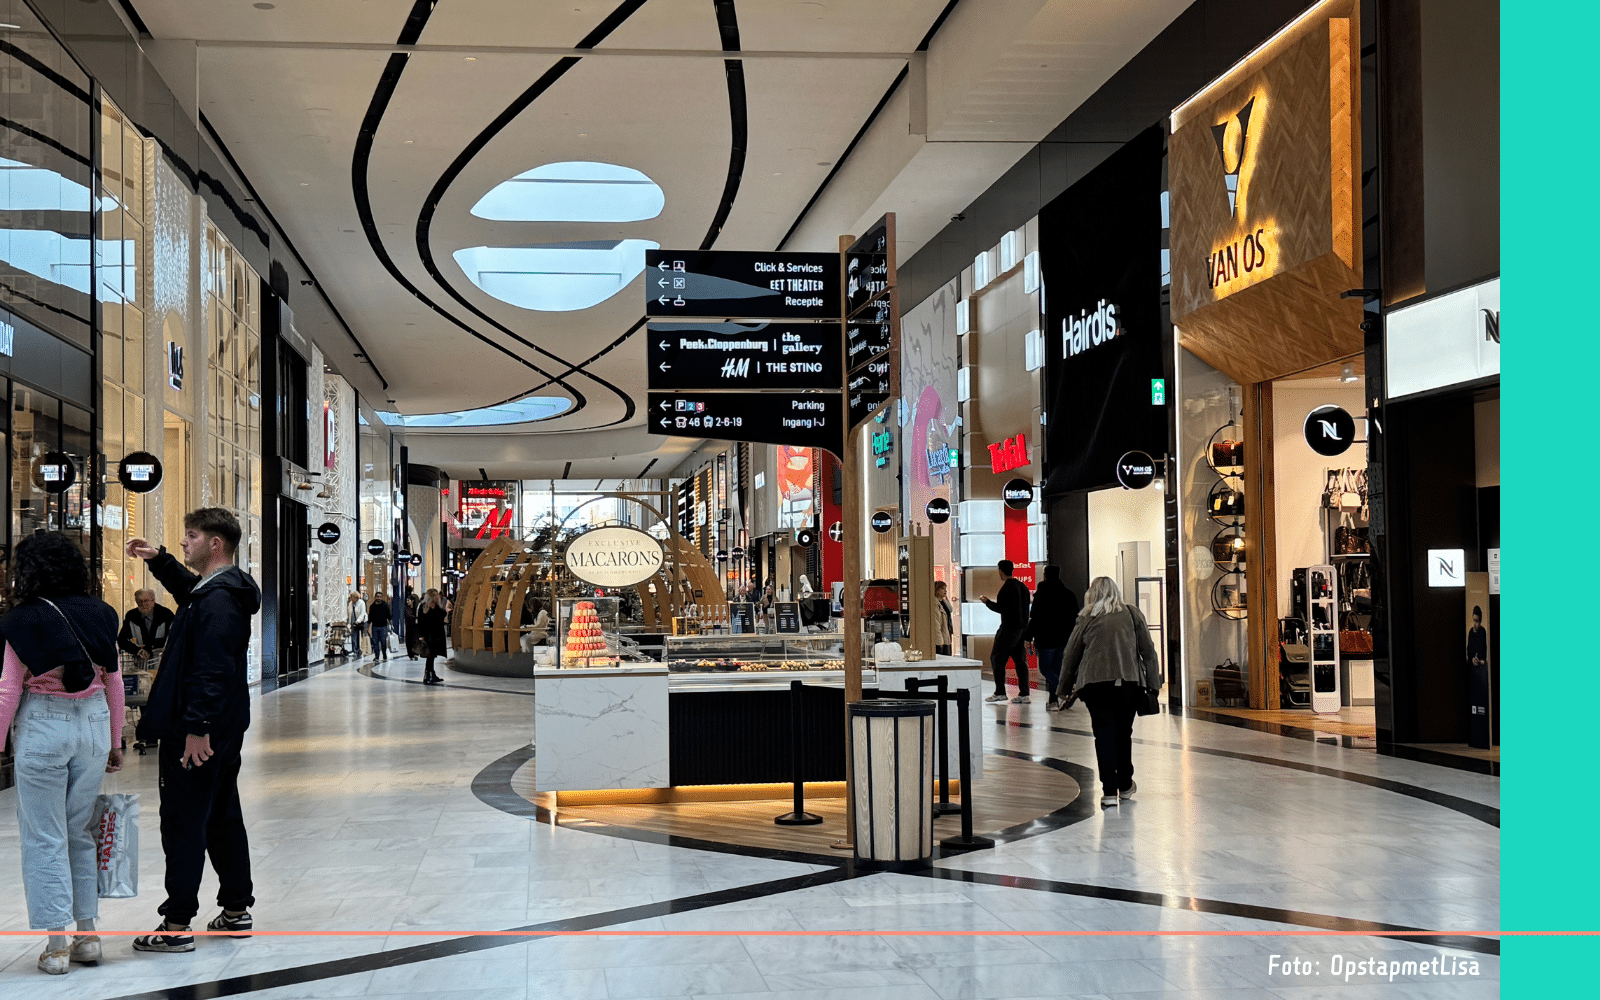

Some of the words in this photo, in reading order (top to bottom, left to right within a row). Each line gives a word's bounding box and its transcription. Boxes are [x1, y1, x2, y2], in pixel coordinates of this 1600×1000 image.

[1205, 242, 1238, 289] VAN
[1243, 229, 1265, 273] OS
[754, 262, 776, 272] Click
[778, 262, 785, 272] &
[786, 262, 823, 273] Services
[770, 279, 785, 291] EET
[786, 279, 823, 292] THEATER
[785, 296, 823, 308] Receptie
[781, 332, 801, 342] the
[782, 342, 822, 355] gallery
[720, 358, 750, 378] H&M
[766, 362, 787, 372] THE
[789, 362, 823, 373] STING
[791, 400, 825, 412] Parking
[715, 417, 742, 427] 2-6-19
[782, 417, 812, 428] Ingang
[570, 550, 660, 567] MACARONS
[101, 811, 117, 871] HADES
